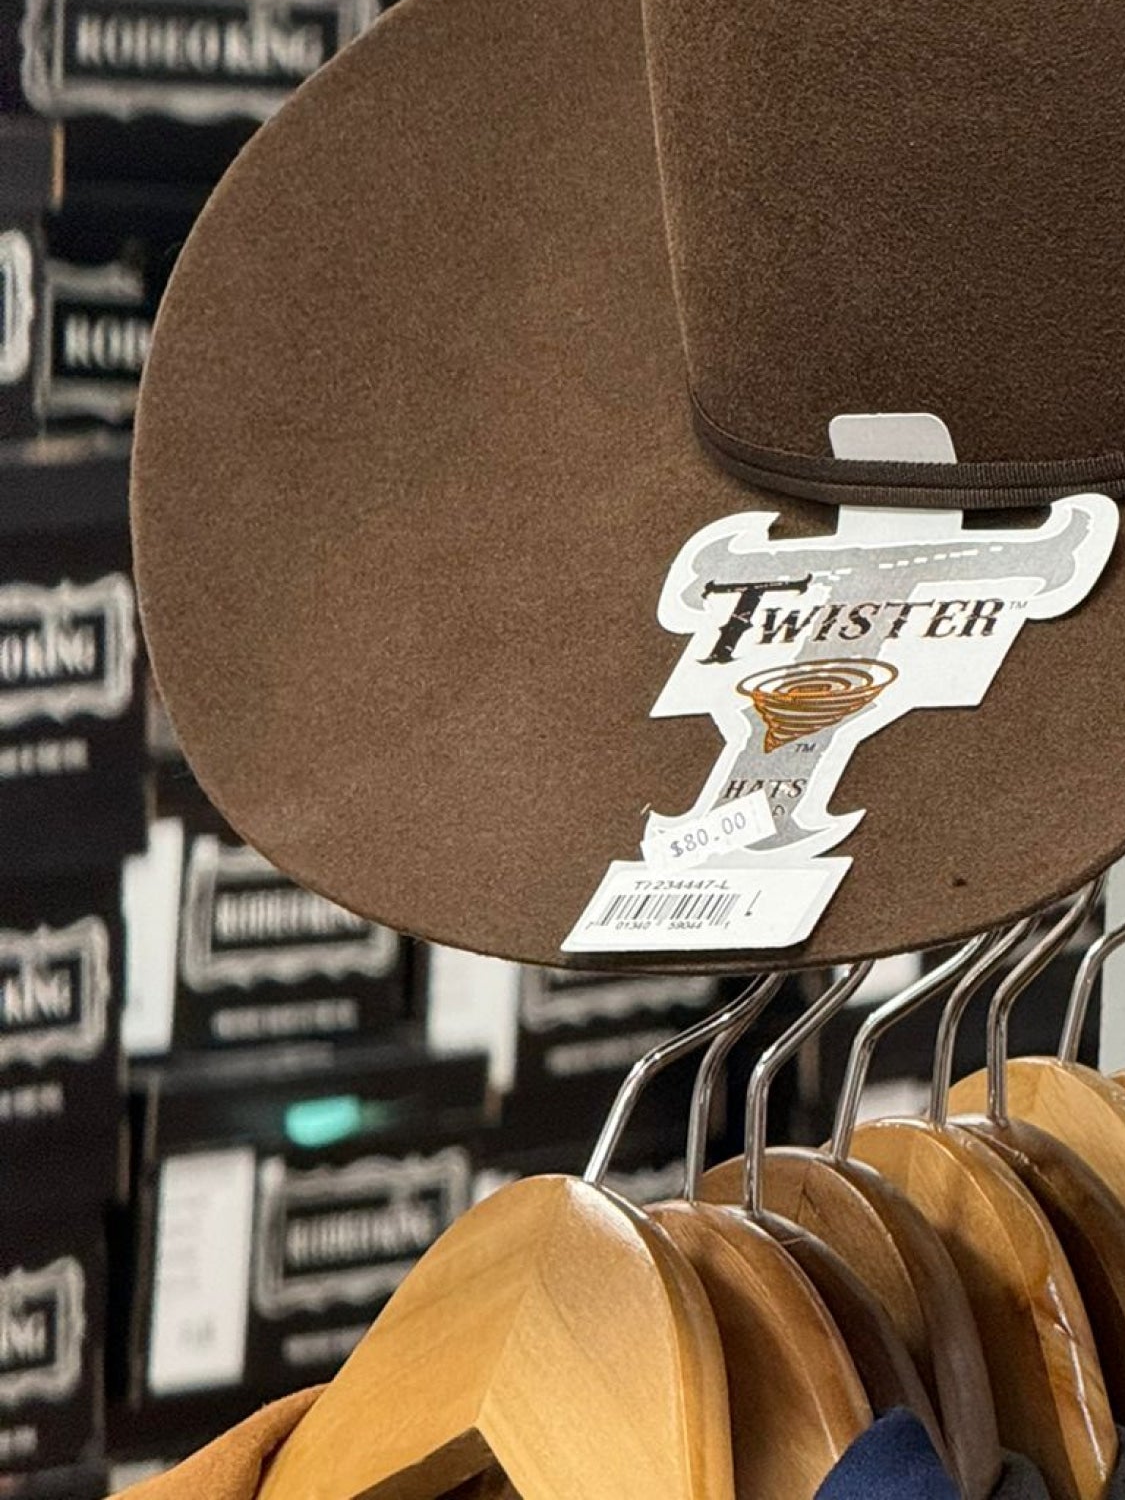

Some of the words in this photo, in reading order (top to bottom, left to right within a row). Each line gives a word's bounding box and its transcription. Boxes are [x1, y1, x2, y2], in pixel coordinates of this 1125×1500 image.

[696, 573, 1006, 665] TWISTER
[724, 778, 808, 800] HATS
[670, 811, 747, 858] $80.00
